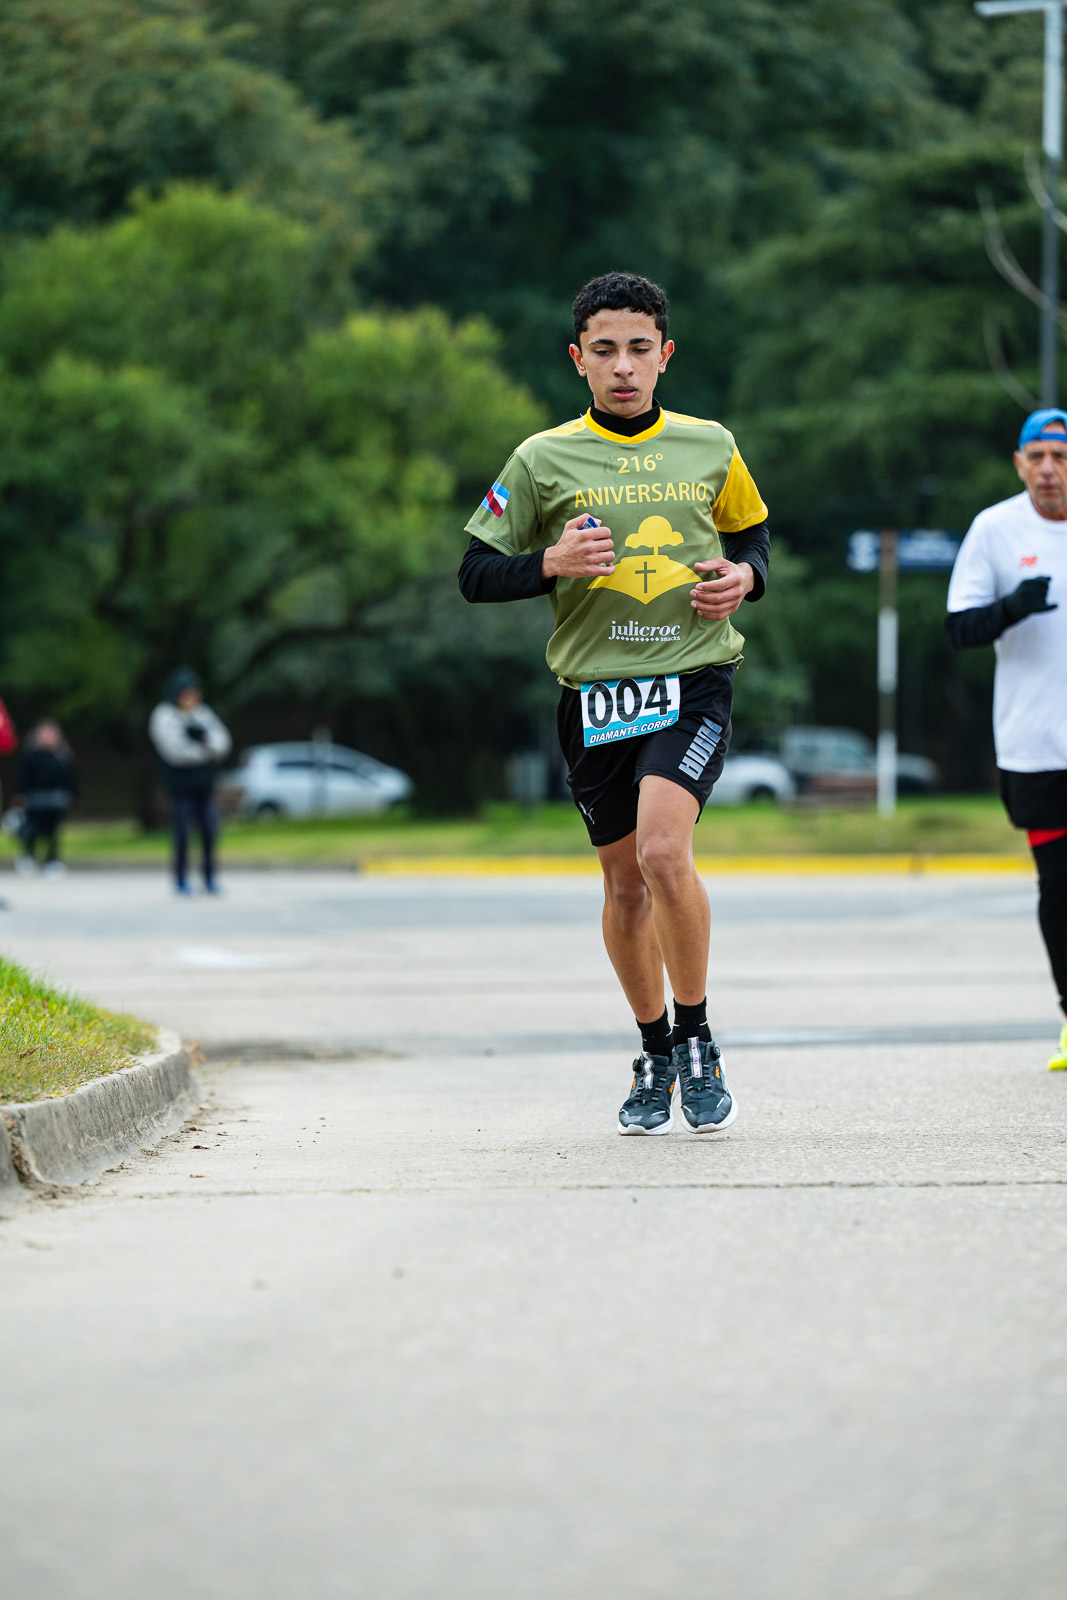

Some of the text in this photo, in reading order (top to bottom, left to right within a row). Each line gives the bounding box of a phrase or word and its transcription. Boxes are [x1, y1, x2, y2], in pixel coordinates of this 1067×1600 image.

[617, 453, 664, 474] 216°
[574, 482, 707, 509] ANIVERSARIO
[608, 620, 681, 640] julicroc
[587, 675, 672, 730] 004
[588, 717, 674, 744] DIAMANTE CORRE
